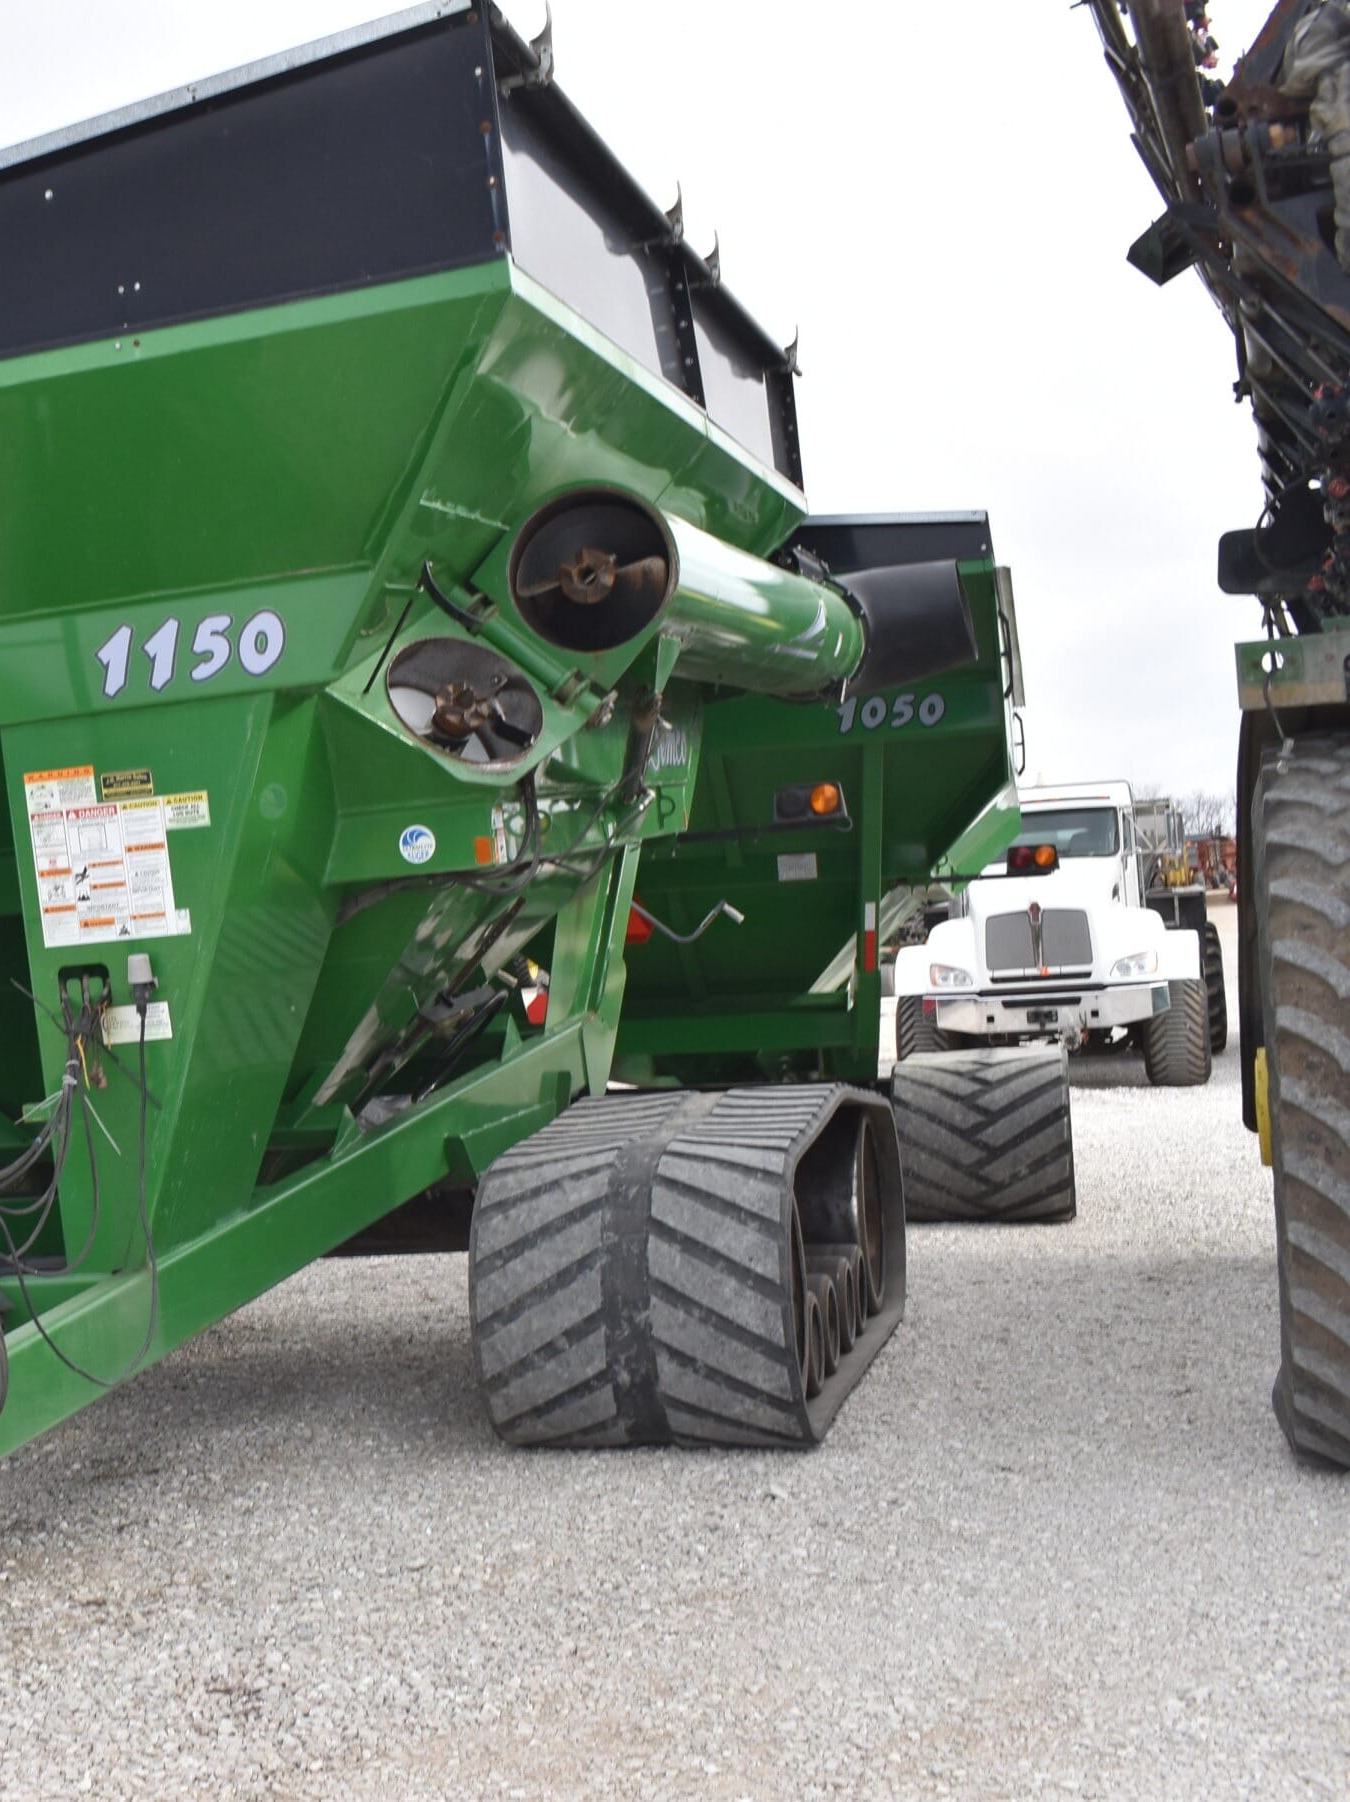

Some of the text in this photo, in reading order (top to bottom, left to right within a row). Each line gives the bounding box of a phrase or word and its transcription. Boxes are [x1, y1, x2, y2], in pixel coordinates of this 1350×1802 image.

[96, 609, 285, 699] 1150
[838, 692, 945, 733] 1050
[79, 806, 115, 819] DANGER
[174, 795, 203, 805] CAUTION
